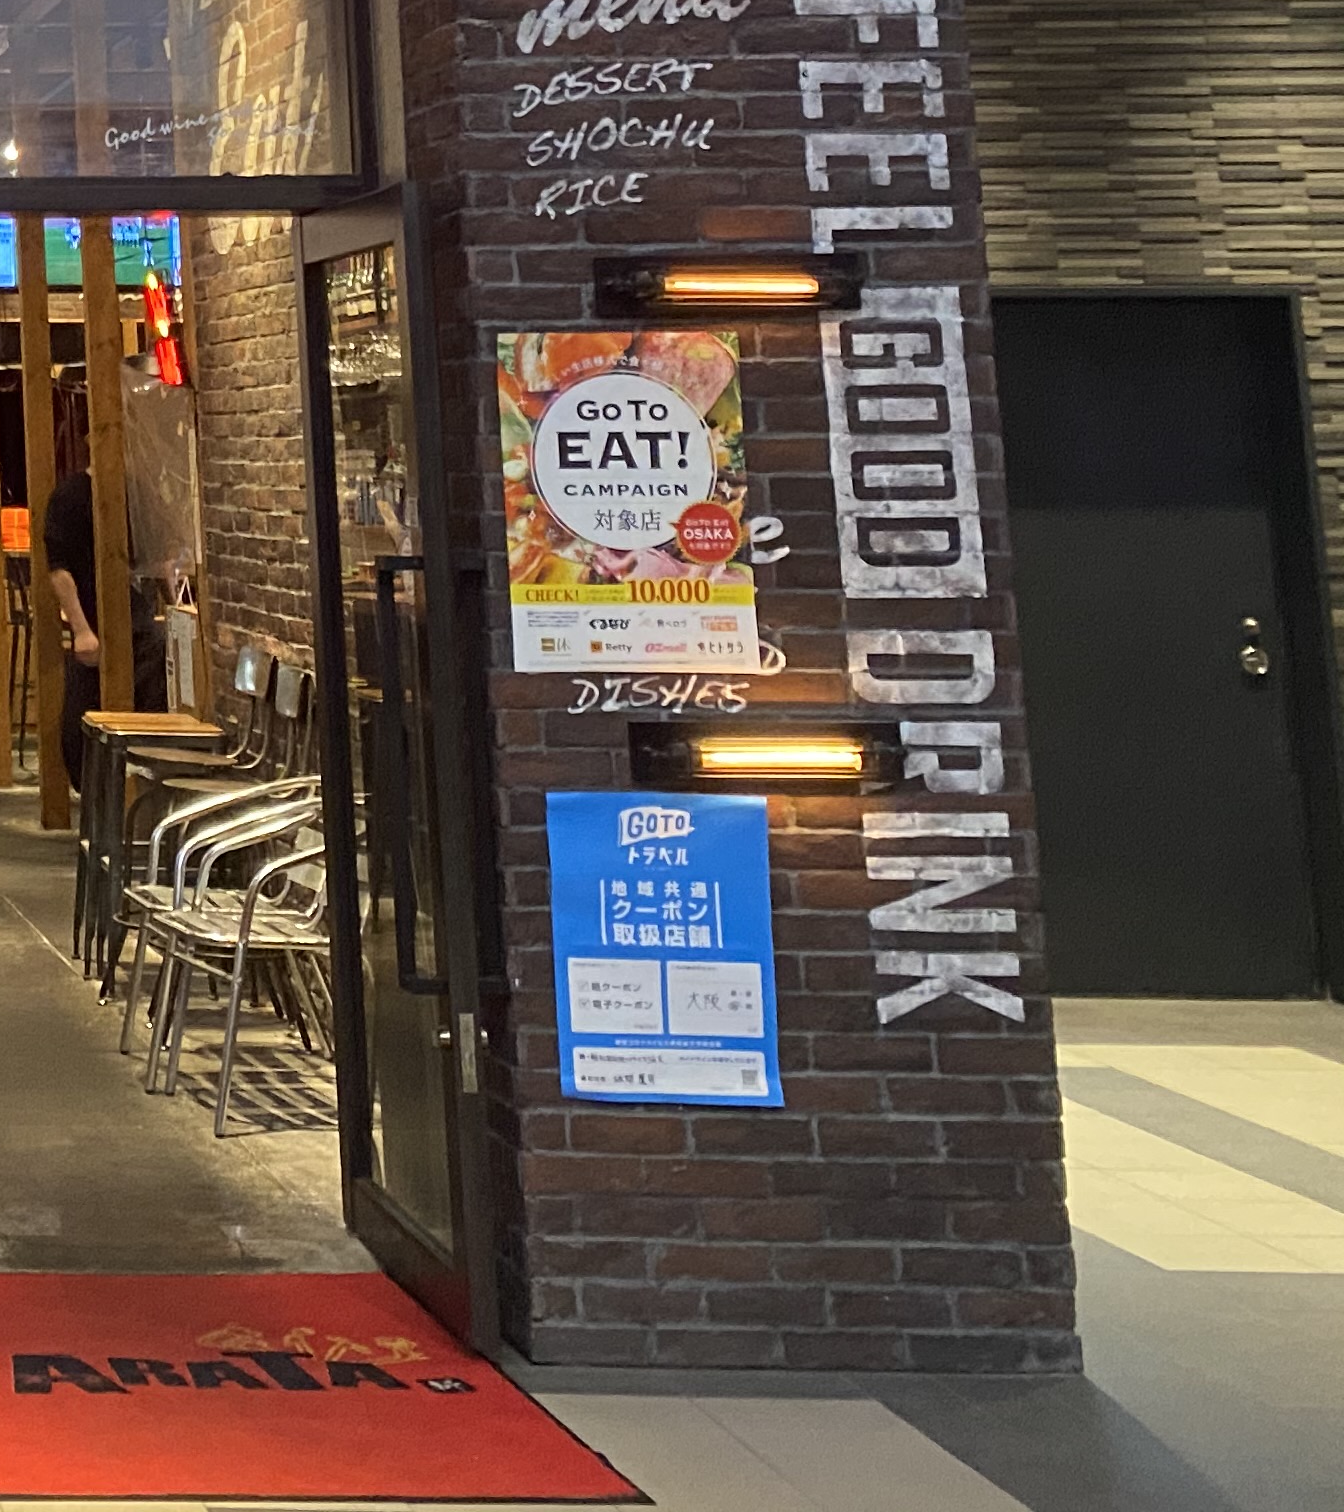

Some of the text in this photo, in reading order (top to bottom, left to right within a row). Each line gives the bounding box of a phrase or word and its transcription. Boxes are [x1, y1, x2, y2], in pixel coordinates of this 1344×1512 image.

[513, 59, 713, 117] DESSERT
[105, 118, 156, 150] Good
[159, 113, 208, 135] wine
[526, 114, 715, 168] SHOCHU
[535, 172, 650, 220] RICE
[557, 431, 691, 470] EAT!
[834, 311, 965, 573] GOOD
[564, 483, 689, 497] CAMPAIGN
[593, 509, 662, 532] 対象店
[683, 527, 734, 540] OSAKA
[526, 588, 580, 602] CHECK!
[627, 579, 710, 604] 10,000
[605, 640, 633, 653] Retty
[568, 678, 749, 715] DISHES
[847, 630, 1025, 1025] DRINK
[628, 846, 689, 866] トラベル
[611, 880, 708, 898] 地域共通
[612, 900, 708, 920] クーポン
[612, 923, 711, 948] 取扱店舗
[12, 1351, 410, 1394] ARATA
